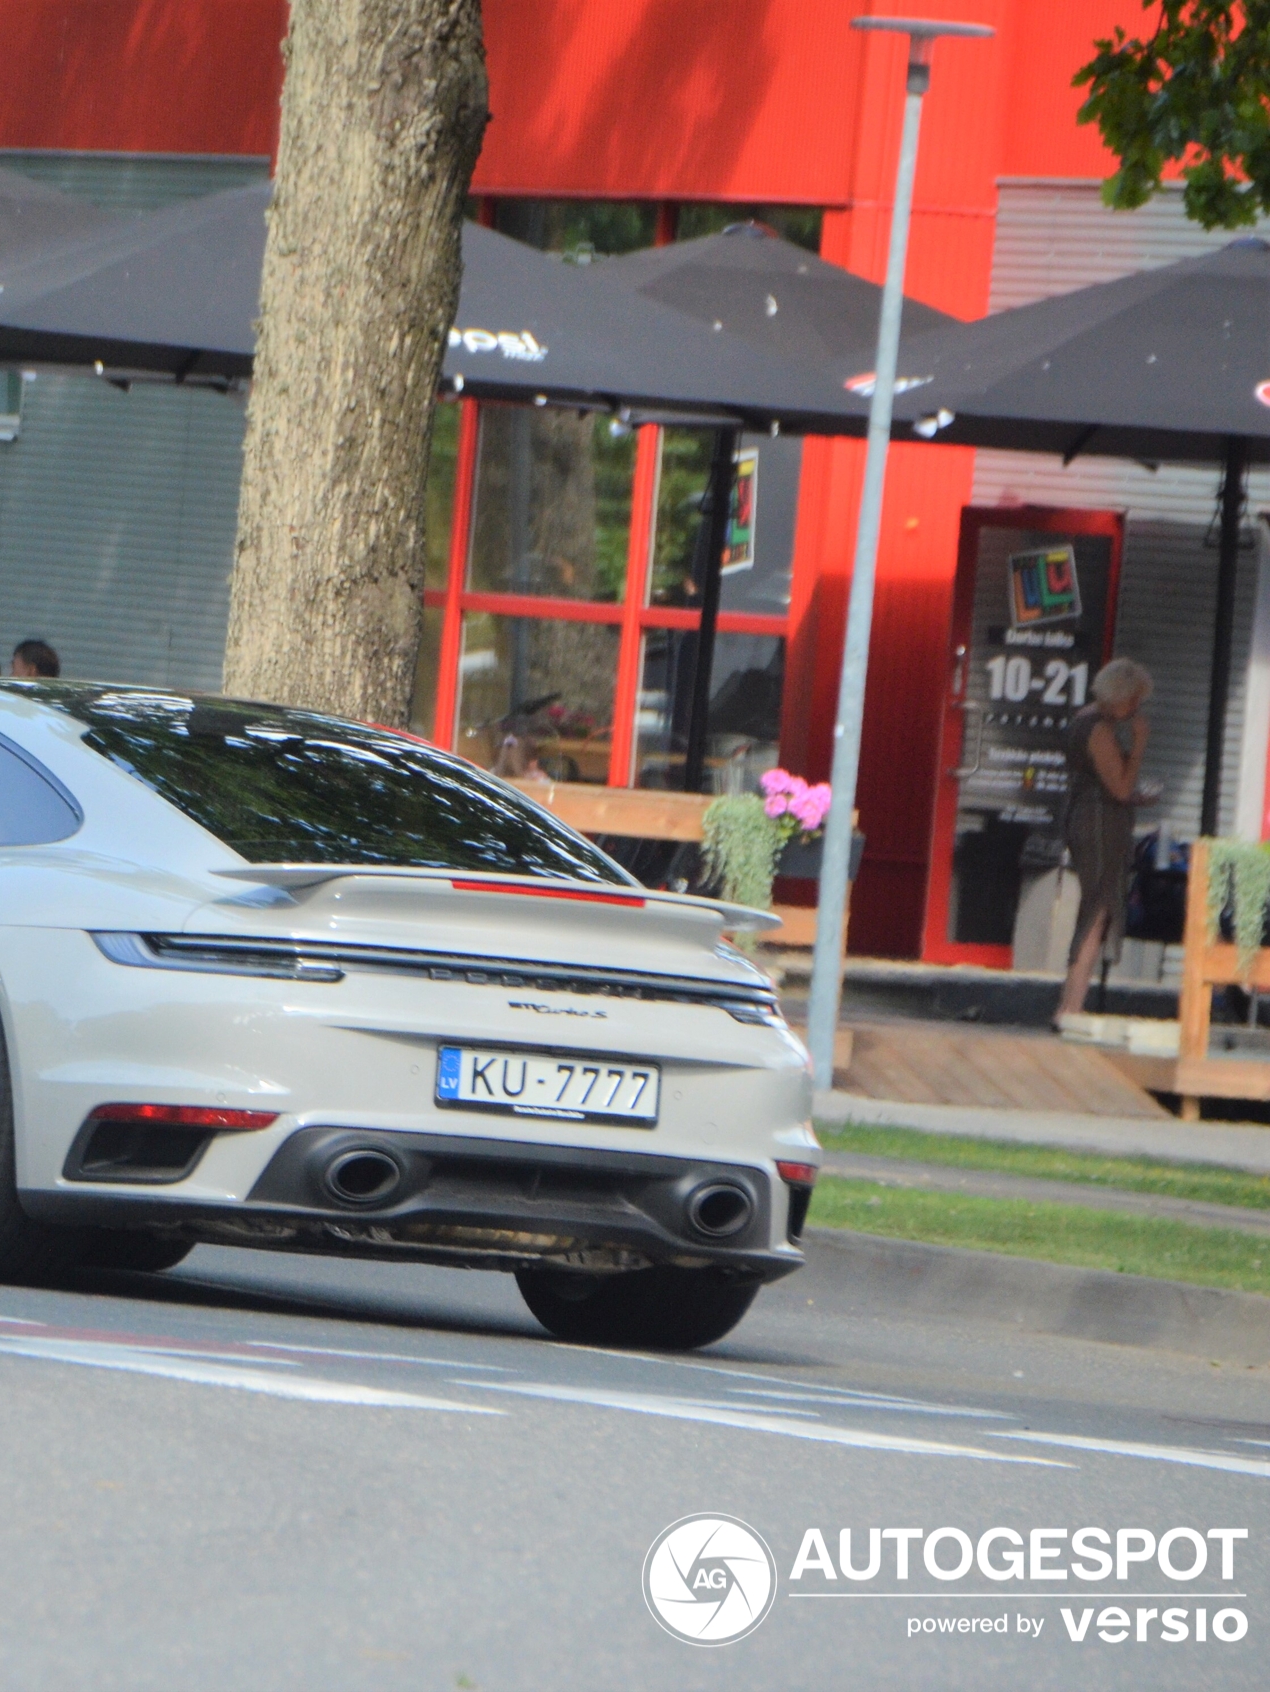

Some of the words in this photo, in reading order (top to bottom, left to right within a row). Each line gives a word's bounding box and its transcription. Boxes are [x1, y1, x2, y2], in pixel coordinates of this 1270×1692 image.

[985, 654, 1089, 708] 10-21
[441, 1077, 458, 1090] LV
[471, 1056, 650, 1109] KU-7777
